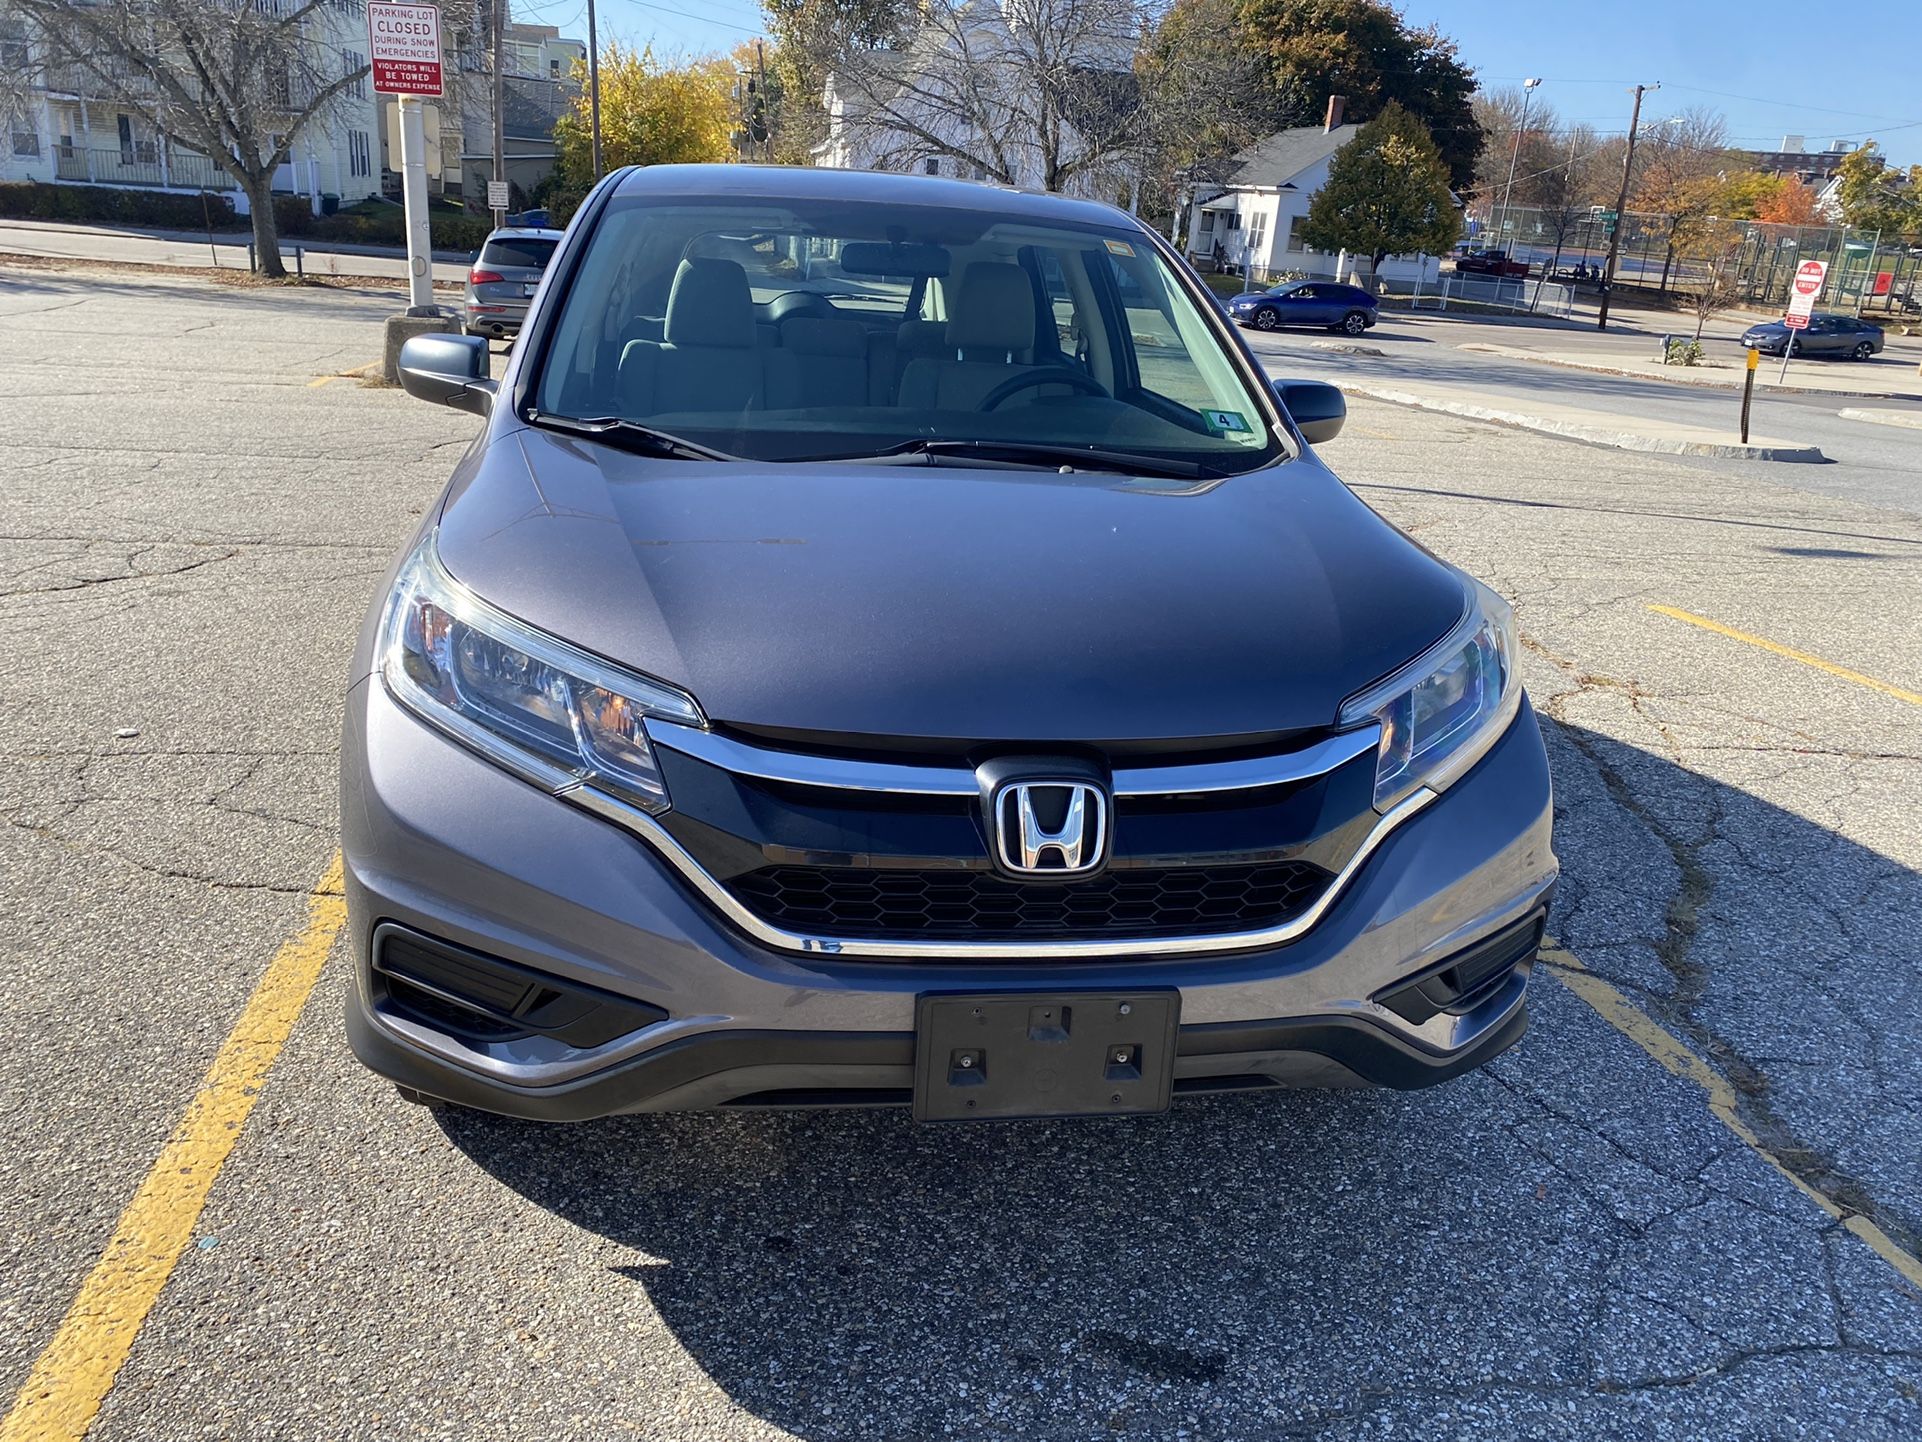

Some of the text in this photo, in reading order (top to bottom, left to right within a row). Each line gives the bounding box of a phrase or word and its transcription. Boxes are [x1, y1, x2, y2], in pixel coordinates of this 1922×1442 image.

[372, 8, 433, 20] PARKING LOT
[377, 20, 431, 35] CLOSED
[374, 35, 435, 47] DURING SNOW
[376, 47, 436, 59] EMERGENCIES
[377, 62, 437, 73] VIOLATORS WILL
[385, 71, 430, 81] BE TOWED
[385, 81, 411, 89] OWNERS
[412, 83, 440, 91] EXPENSE
[1219, 414, 1230, 426] 4
